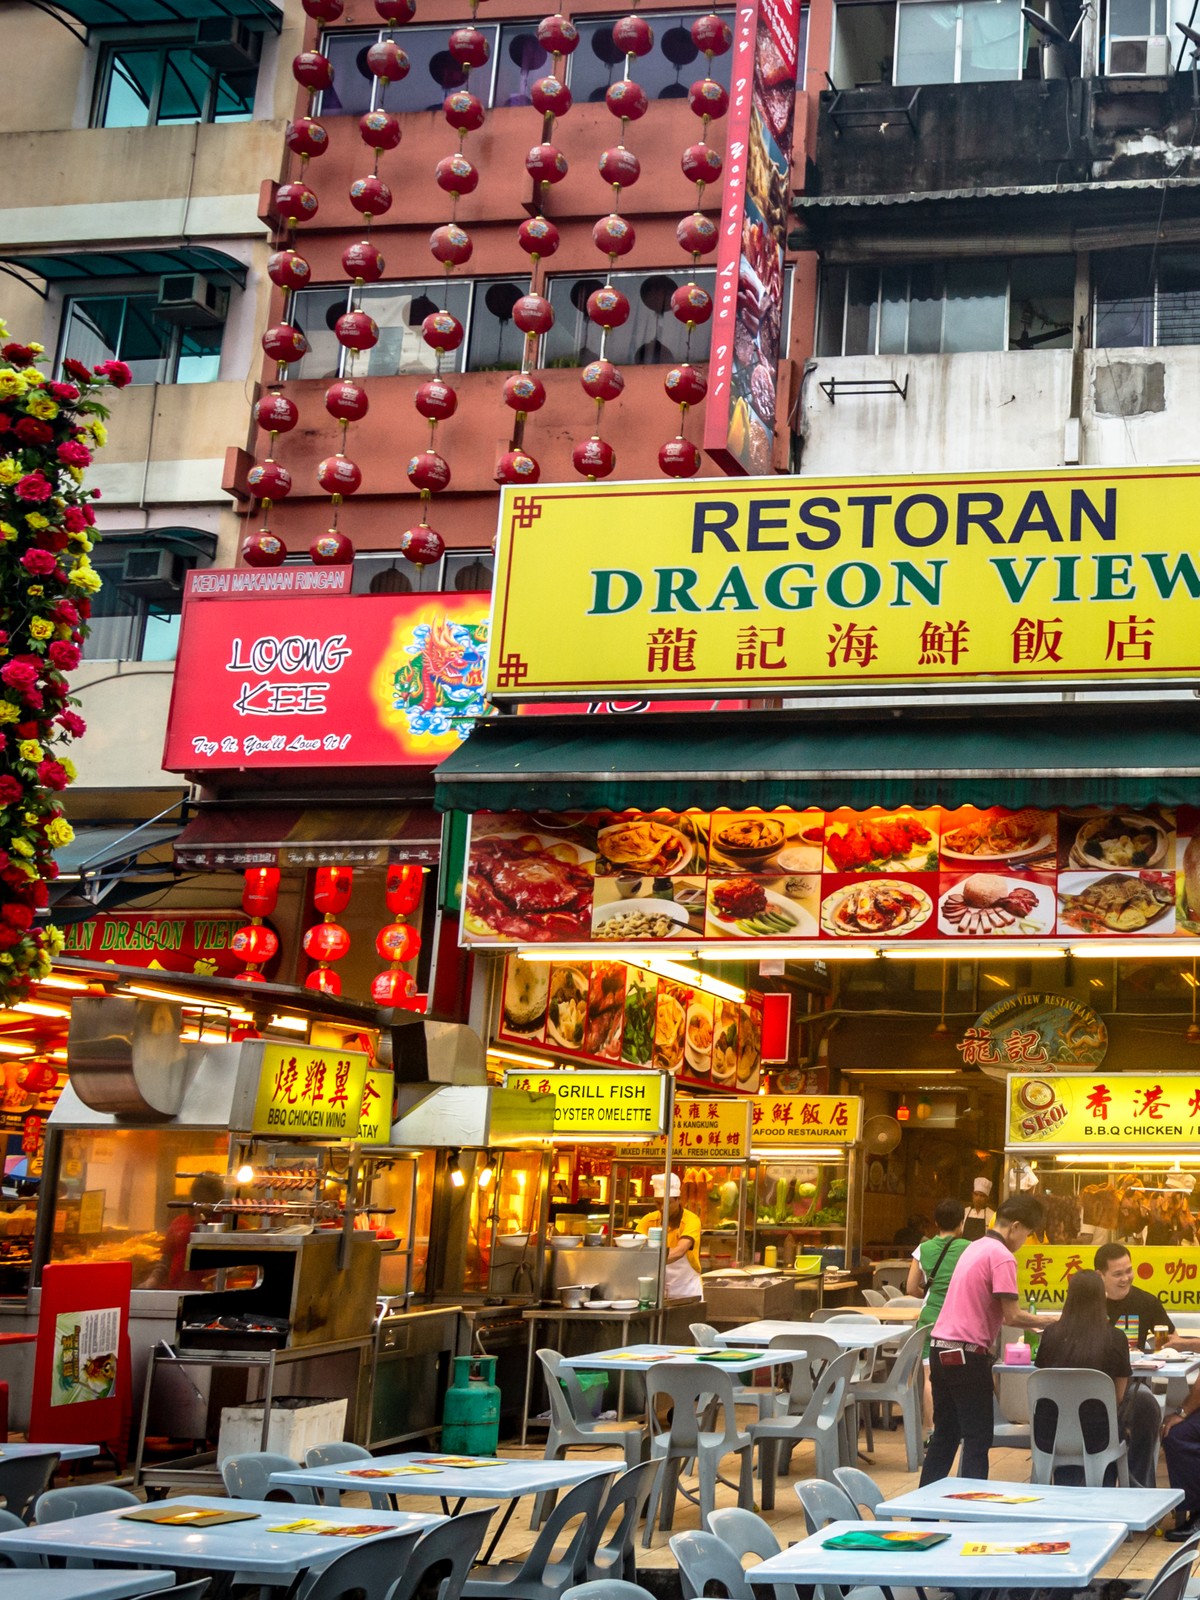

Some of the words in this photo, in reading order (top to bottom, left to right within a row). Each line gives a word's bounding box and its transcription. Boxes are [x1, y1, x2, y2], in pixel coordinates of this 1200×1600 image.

[740, 8, 753, 52] Try
[719, 261, 736, 319] Love
[692, 486, 1118, 554] RESTORAN
[192, 573, 230, 592] KEDAI
[232, 572, 293, 591] MAKANAN
[295, 570, 344, 590] RINGAN
[586, 559, 950, 616] DRAGON
[227, 635, 351, 675] LOONG
[647, 615, 1155, 673] 龍記海鮮飯店
[234, 680, 329, 715] KEE
[192, 736, 218, 756] Try
[243, 735, 286, 755] You'll
[286, 735, 321, 751] Love
[102, 921, 186, 950] DRAGON
[981, 999, 1017, 1026] DRAGON
[1018, 994, 1042, 1006] VIEW
[1045, 995, 1098, 1026] RESTAURANT
[957, 1028, 1049, 1065] 龍記
[558, 1085, 604, 1099] GRILL
[610, 1085, 645, 1099] FISH
[267, 1108, 287, 1125] BBQ
[288, 1110, 323, 1127] CHICKEN
[326, 1112, 346, 1128] WING
[554, 1107, 594, 1121] OYSTER
[597, 1108, 651, 1121] OMELETTE
[683, 1120, 719, 1129] KANGKUNG
[1021, 1103, 1068, 1138] SKOL
[358, 1124, 379, 1139] ATAY
[752, 1128, 785, 1136] AFOOD
[787, 1128, 848, 1136] RESTAURANT
[1084, 1126, 1120, 1137] B.B.Q
[1123, 1125, 1182, 1136] CHICKEN
[621, 1146, 640, 1155] MIXED
[642, 1147, 659, 1156] FRUIT
[660, 1147, 682, 1156] RJAK
[688, 1147, 709, 1156] FRESH
[710, 1147, 741, 1157] COCKLES
